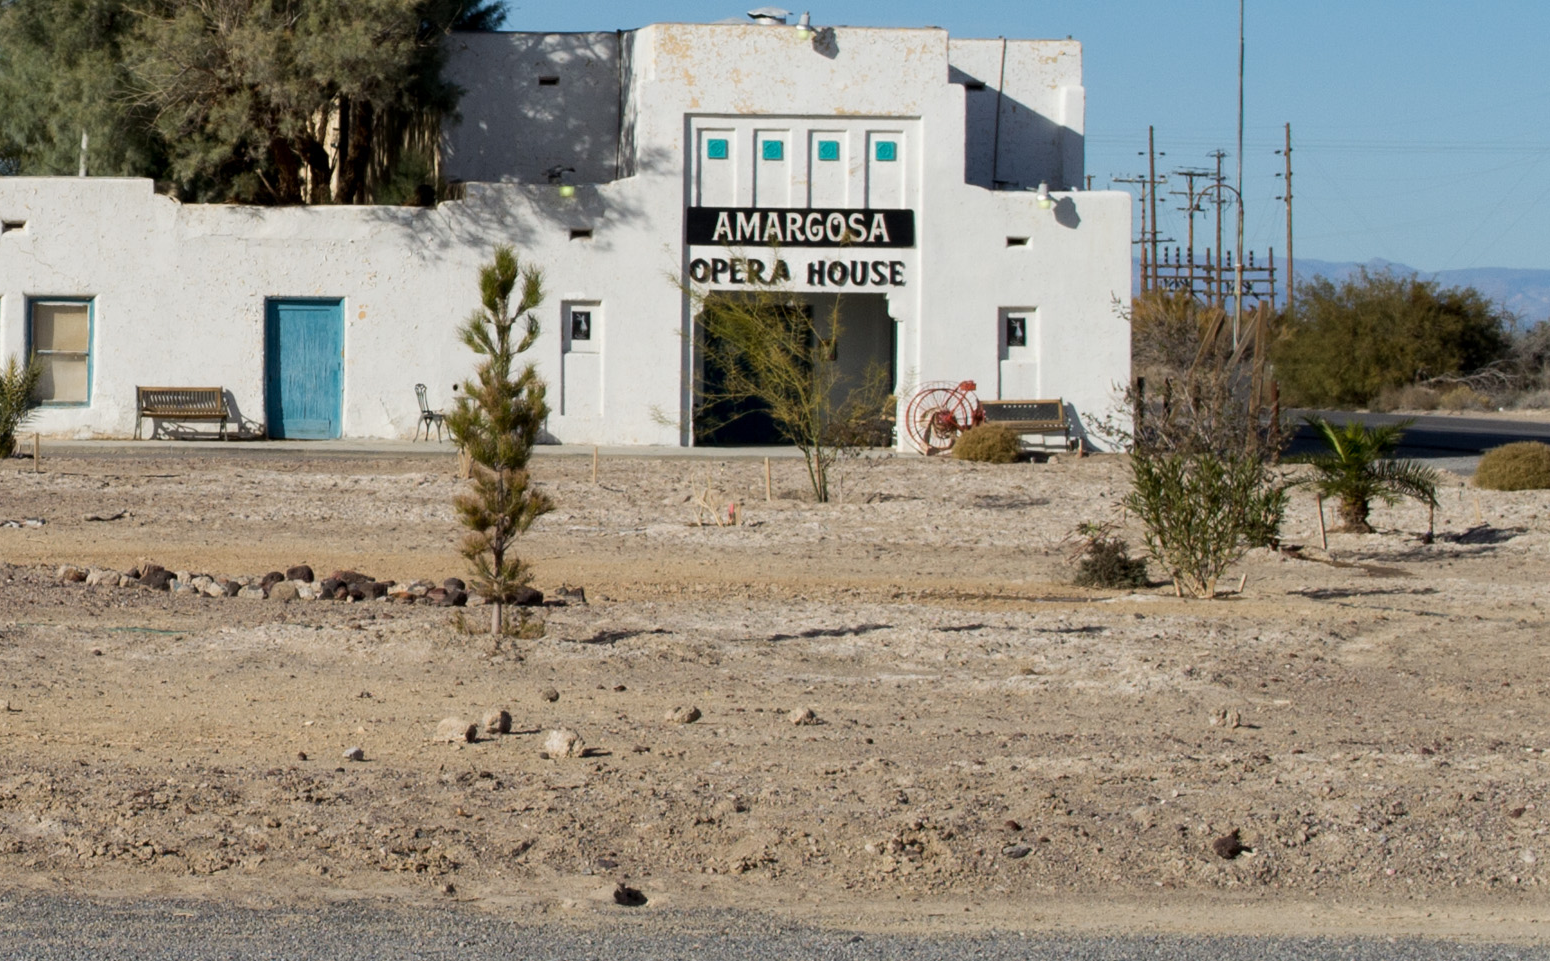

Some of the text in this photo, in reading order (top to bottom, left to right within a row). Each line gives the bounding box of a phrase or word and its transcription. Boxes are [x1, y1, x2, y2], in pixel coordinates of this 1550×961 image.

[712, 211, 890, 242] AMARGOSA
[690, 258, 906, 286] OPERA HOUSE
